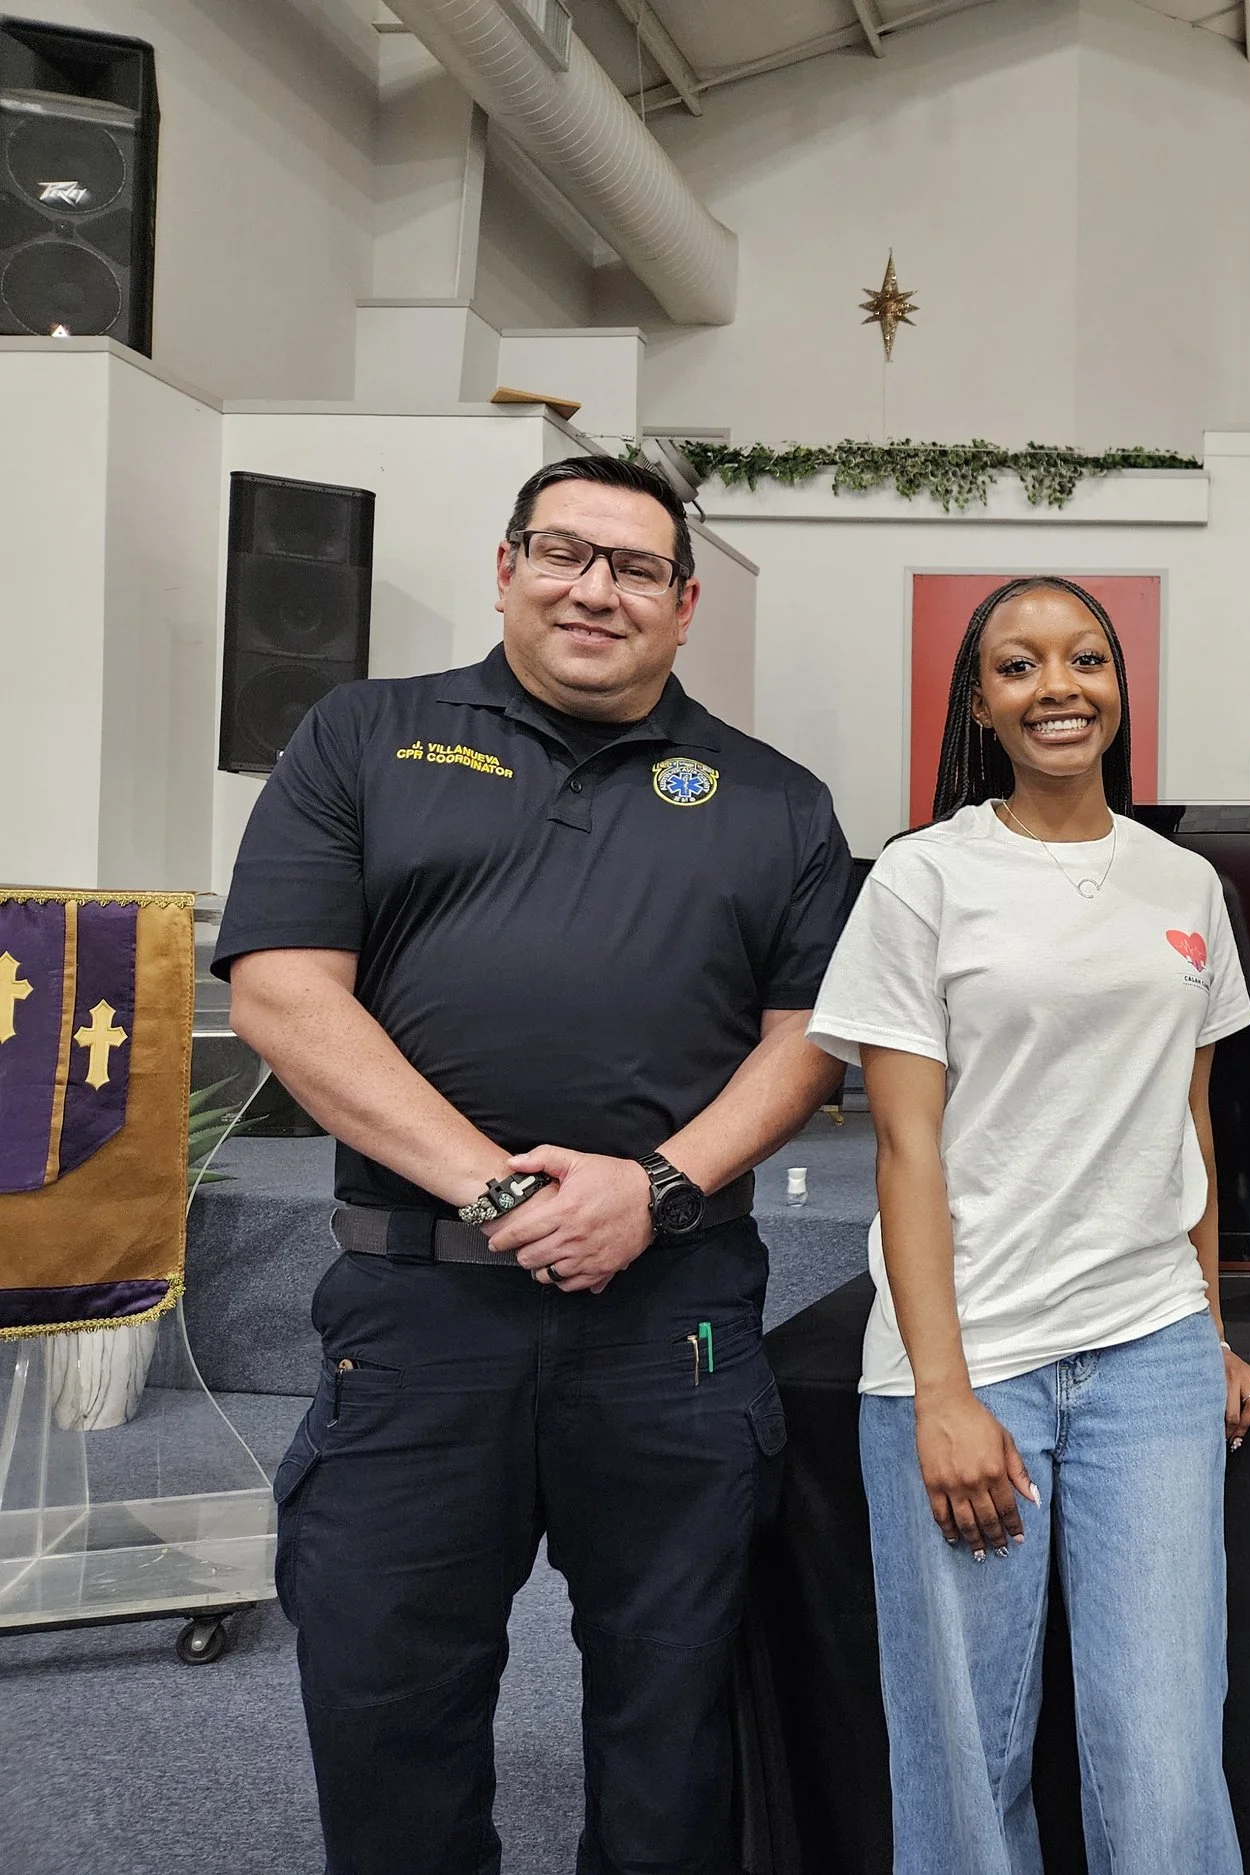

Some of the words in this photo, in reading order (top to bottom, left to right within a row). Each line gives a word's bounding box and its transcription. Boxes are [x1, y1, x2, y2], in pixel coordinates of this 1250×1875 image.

[396, 749, 423, 760] CPR
[426, 752, 513, 778] COORDINATOR
[412, 740, 423, 750] J.
[428, 743, 500, 766] VILLANUEVA
